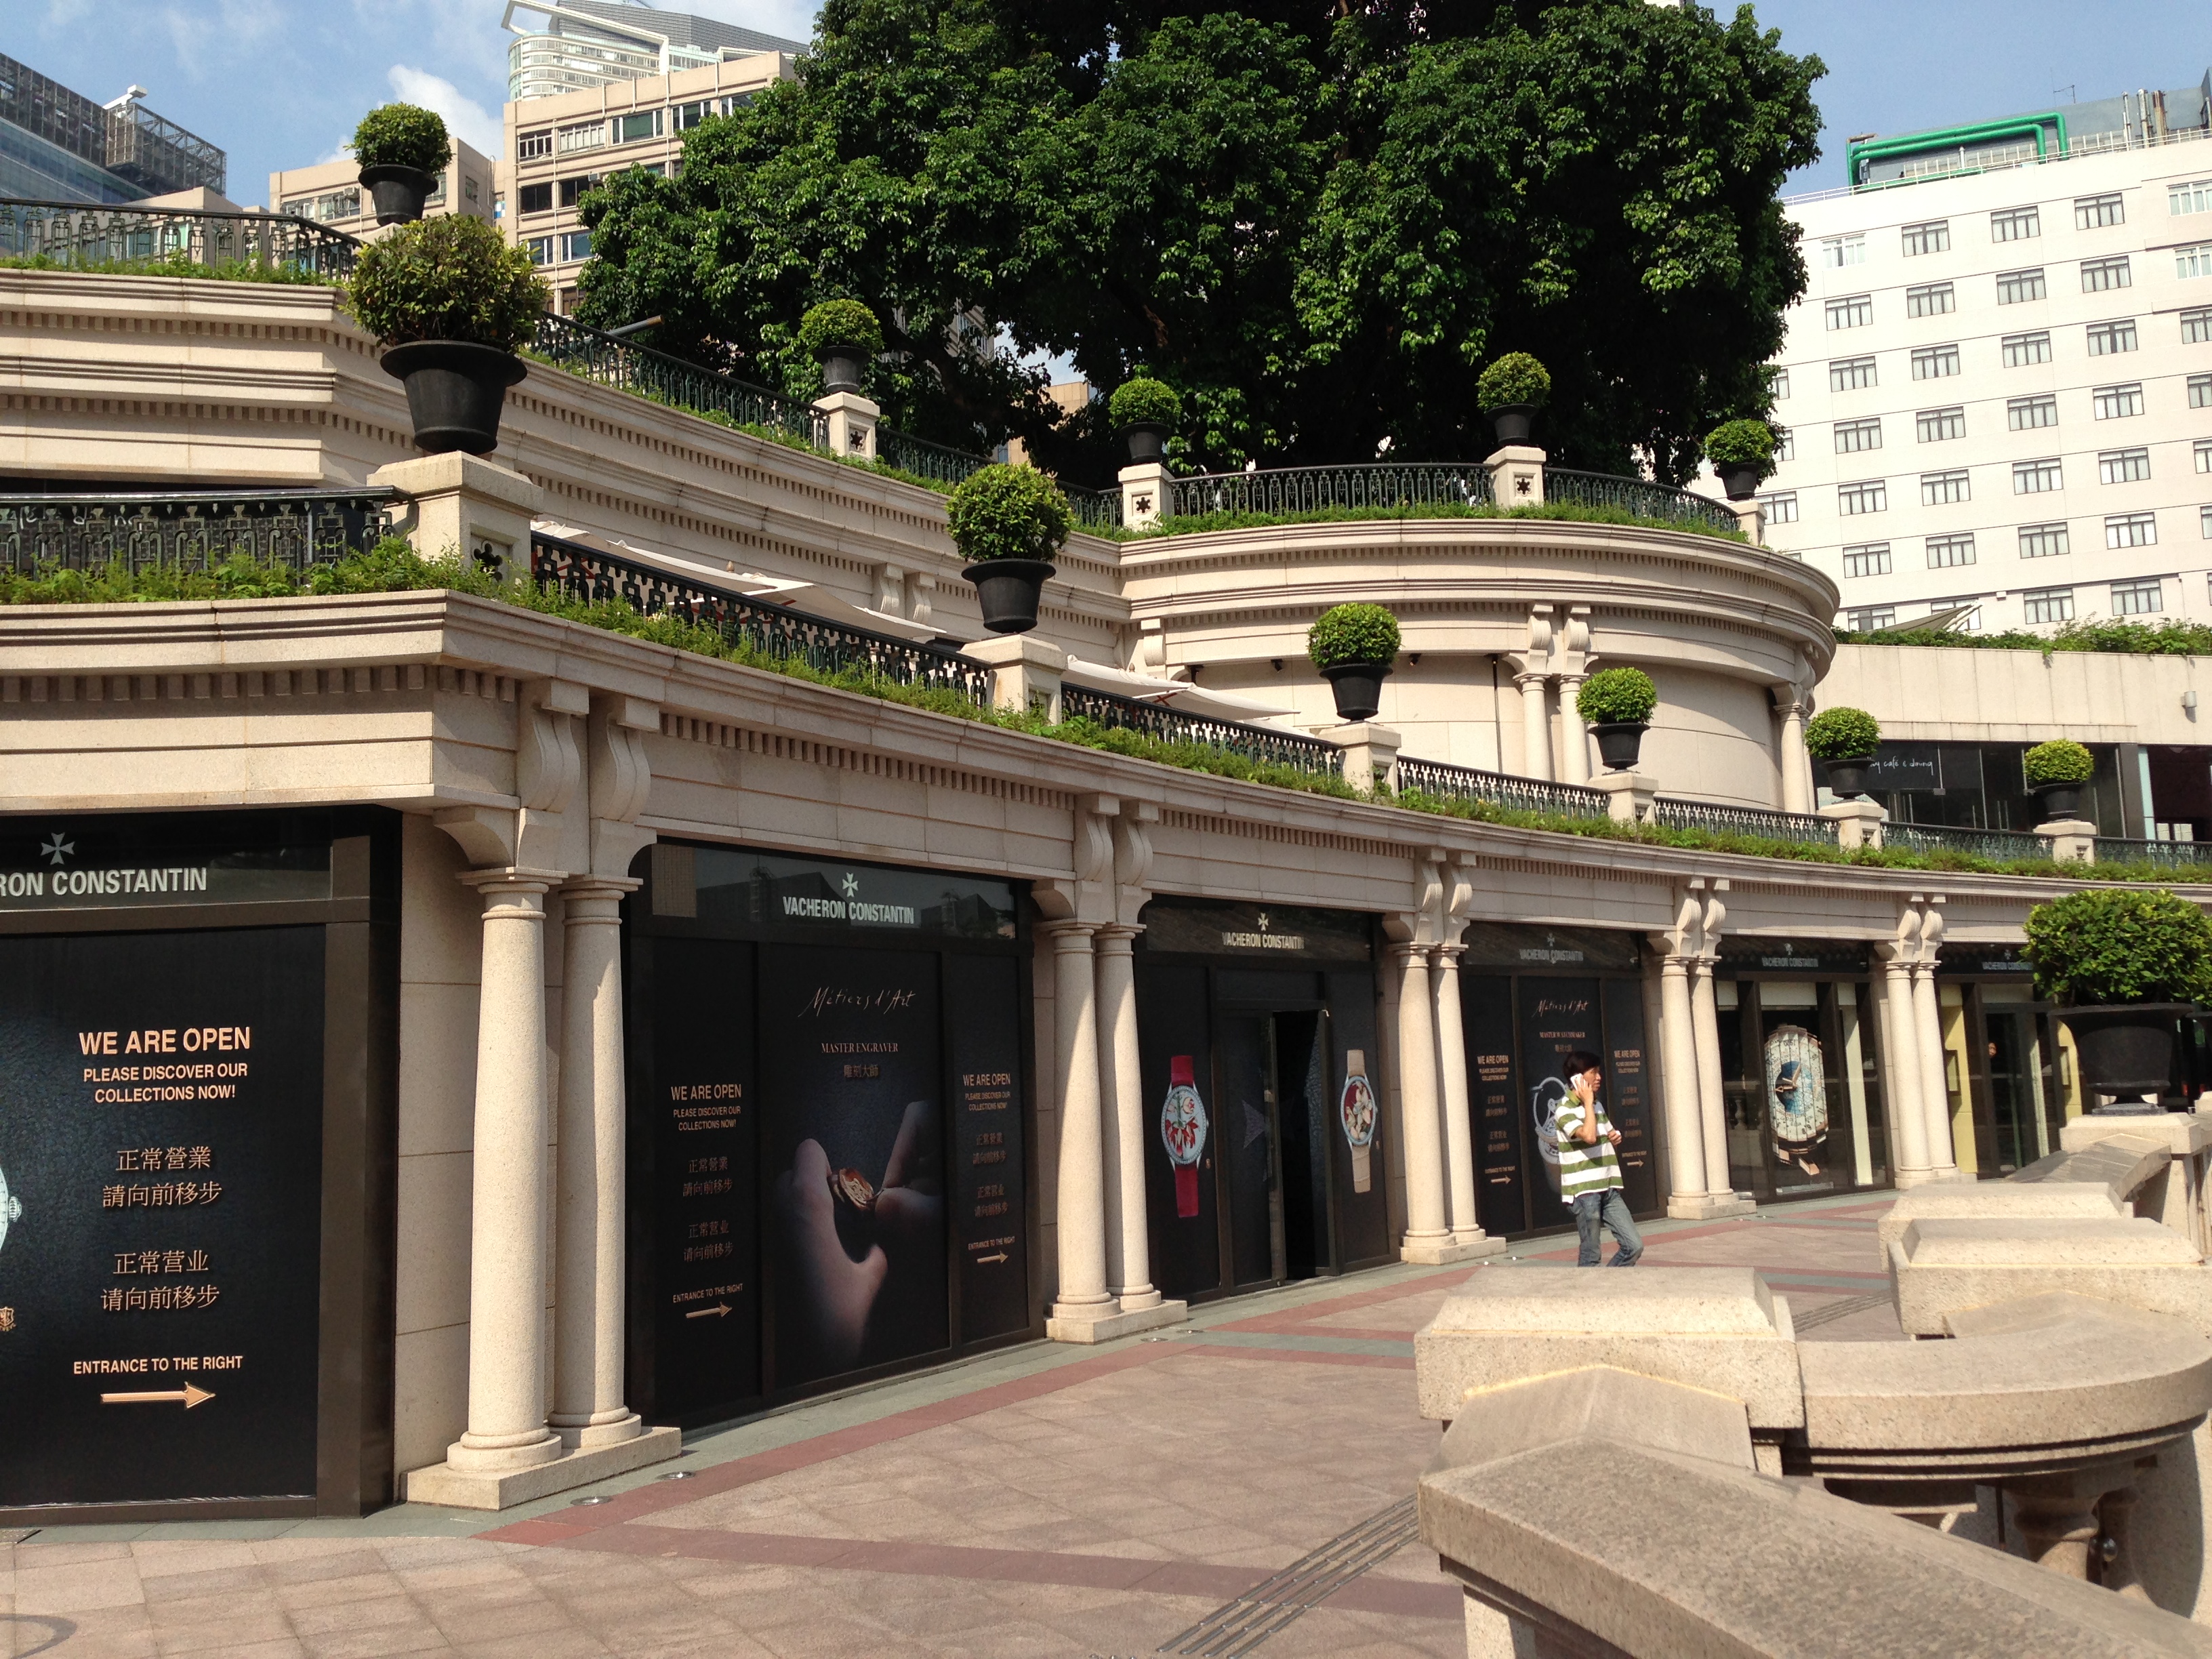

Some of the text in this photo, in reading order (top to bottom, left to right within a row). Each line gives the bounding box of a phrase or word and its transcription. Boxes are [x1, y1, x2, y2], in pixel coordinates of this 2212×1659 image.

[52, 867, 207, 896] CONSTANTIN
[783, 896, 914, 924] VACHERON CONSTANTIN
[1221, 932, 1305, 949] VACHERON CONSTANTIN
[798, 986, 916, 1017] Métiers d'Art
[79, 1027, 250, 1055] WE ARE OPEN
[821, 1042, 899, 1052] MASTER ENGRAVER
[1477, 1054, 1509, 1065] WE ARE OPEN
[83, 1063, 248, 1082] PLEASE DISCOVER OUR
[963, 1073, 1011, 1086] WE ARE OPEN
[95, 1084, 236, 1103] COLLECTIONS NOW!
[670, 1084, 741, 1101] WE ARE OPEN
[673, 1105, 741, 1118] PLEASE DISCOVER OUR
[678, 1119, 737, 1131] COLLECTIONS NOW!
[115, 1146, 211, 1171] 正常營業
[689, 1156, 728, 1173] 正常營業
[102, 1181, 222, 1208] 請向前移步
[682, 1178, 733, 1197] 請向前移步
[689, 1220, 729, 1239] 正常营业
[112, 1250, 209, 1275] 正常营业
[100, 1284, 220, 1312] 请向前移步
[673, 1283, 743, 1303] ENTRANCE TO THE RIGHT
[73, 1355, 244, 1374] ENTRANCE TO THE RIGHT
